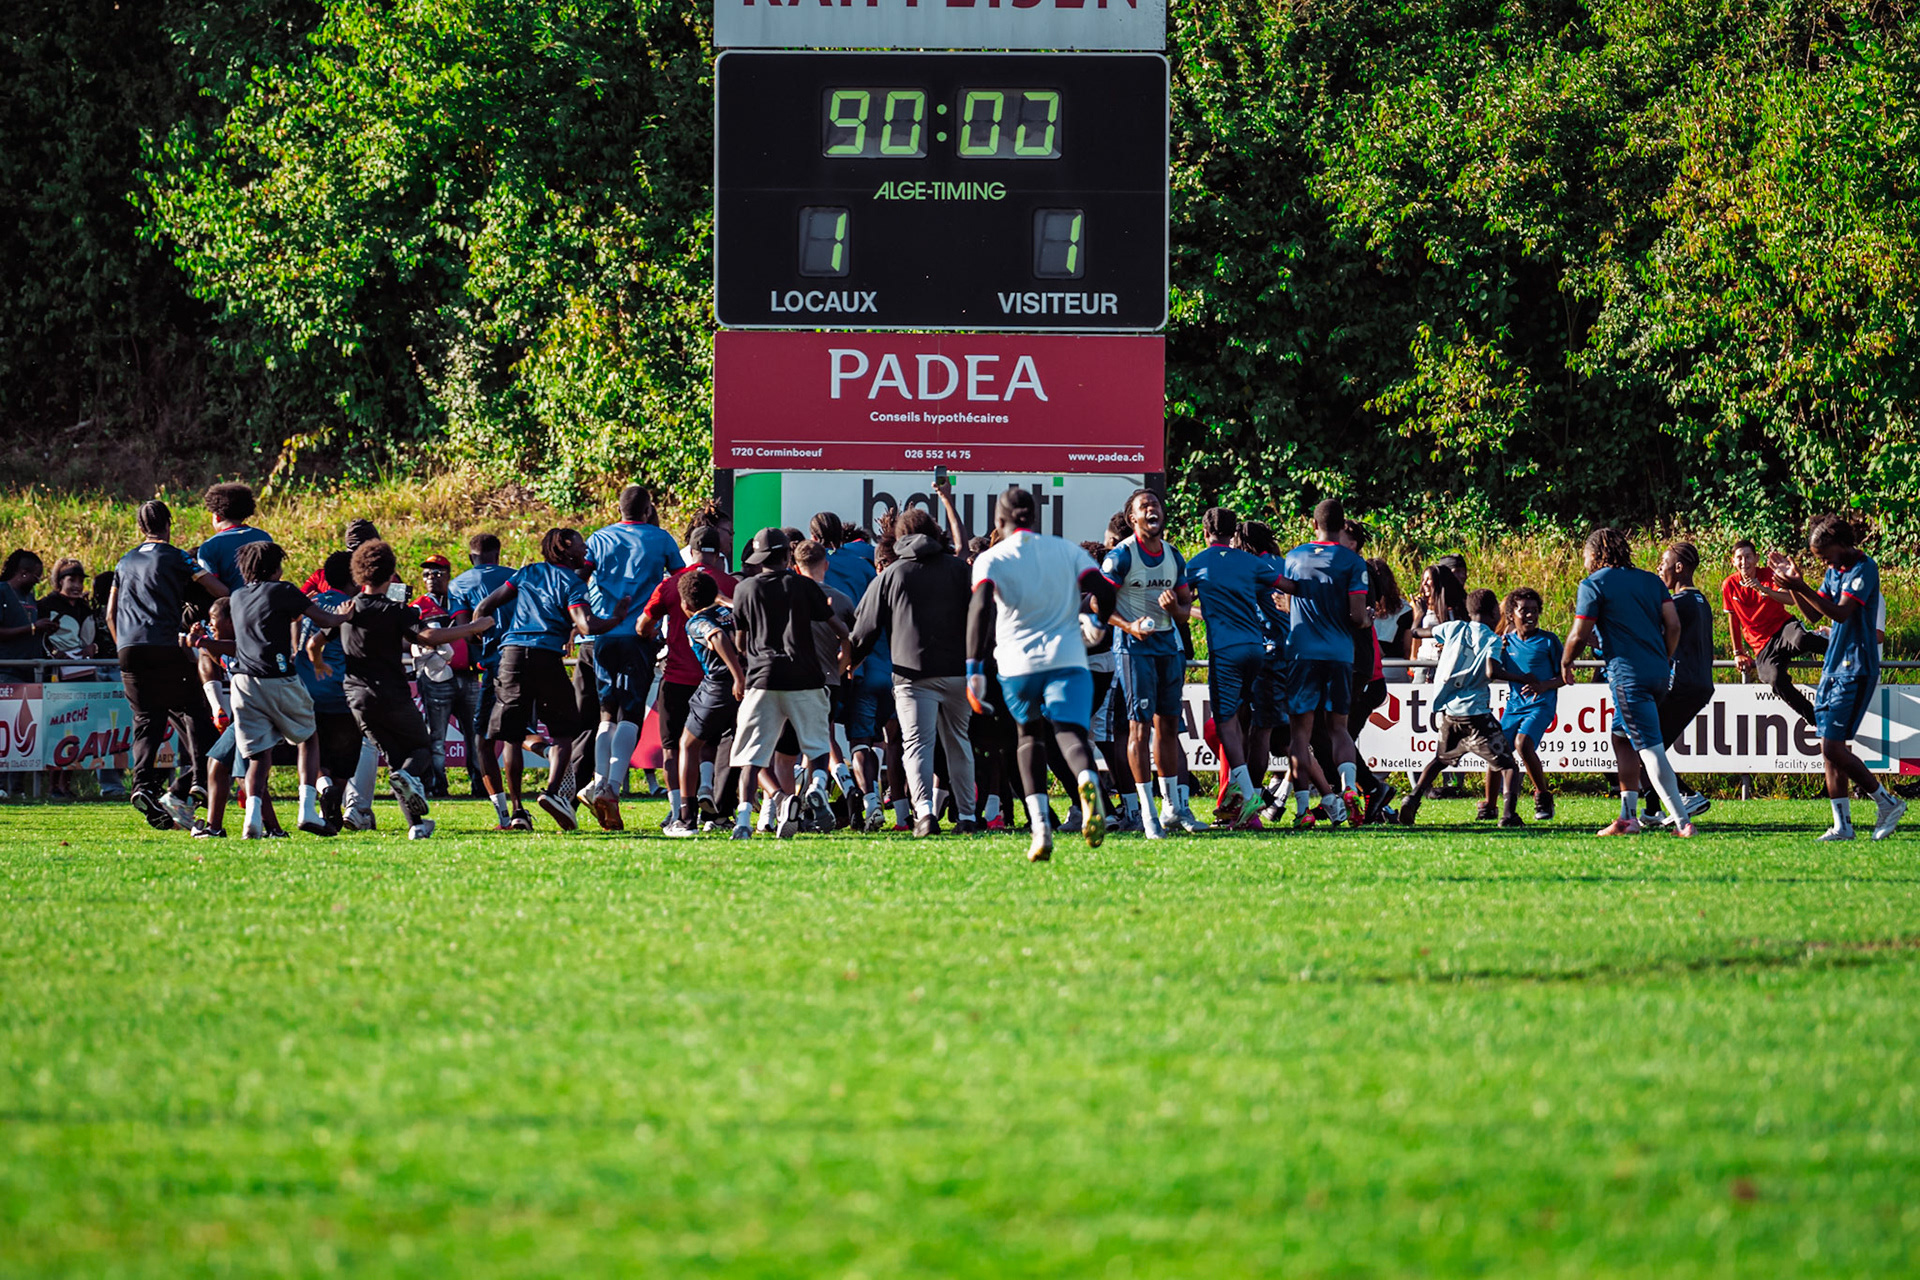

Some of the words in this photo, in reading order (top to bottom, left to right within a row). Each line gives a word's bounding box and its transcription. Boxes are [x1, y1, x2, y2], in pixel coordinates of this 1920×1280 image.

[873, 181, 1007, 201] ALGE-TIMING
[831, 212, 847, 272] 1
[1065, 213, 1082, 274] 1
[770, 290, 878, 313] LOCAUX
[997, 292, 1118, 315] VISITEUR
[828, 348, 1049, 402] PADEA
[869, 411, 921, 422] Conseils
[923, 412, 1009, 424] hypothécaires
[731, 447, 754, 457] 1720
[755, 447, 823, 457] Corminboeuf
[904, 450, 924, 459] 026
[925, 450, 944, 459] 552
[946, 450, 958, 459] 14
[959, 450, 971, 460] 75
[1068, 452, 1145, 464] www.padea.ch
[1146, 579, 1172, 588] JAKO
[50, 702, 89, 726] MARCHÉ
[1539, 740, 1564, 753] 919
[1571, 740, 1587, 753] 19
[1593, 740, 1609, 753] 10
[1380, 758, 1423, 768] Nacelles
[1774, 758, 1809, 771] facility
